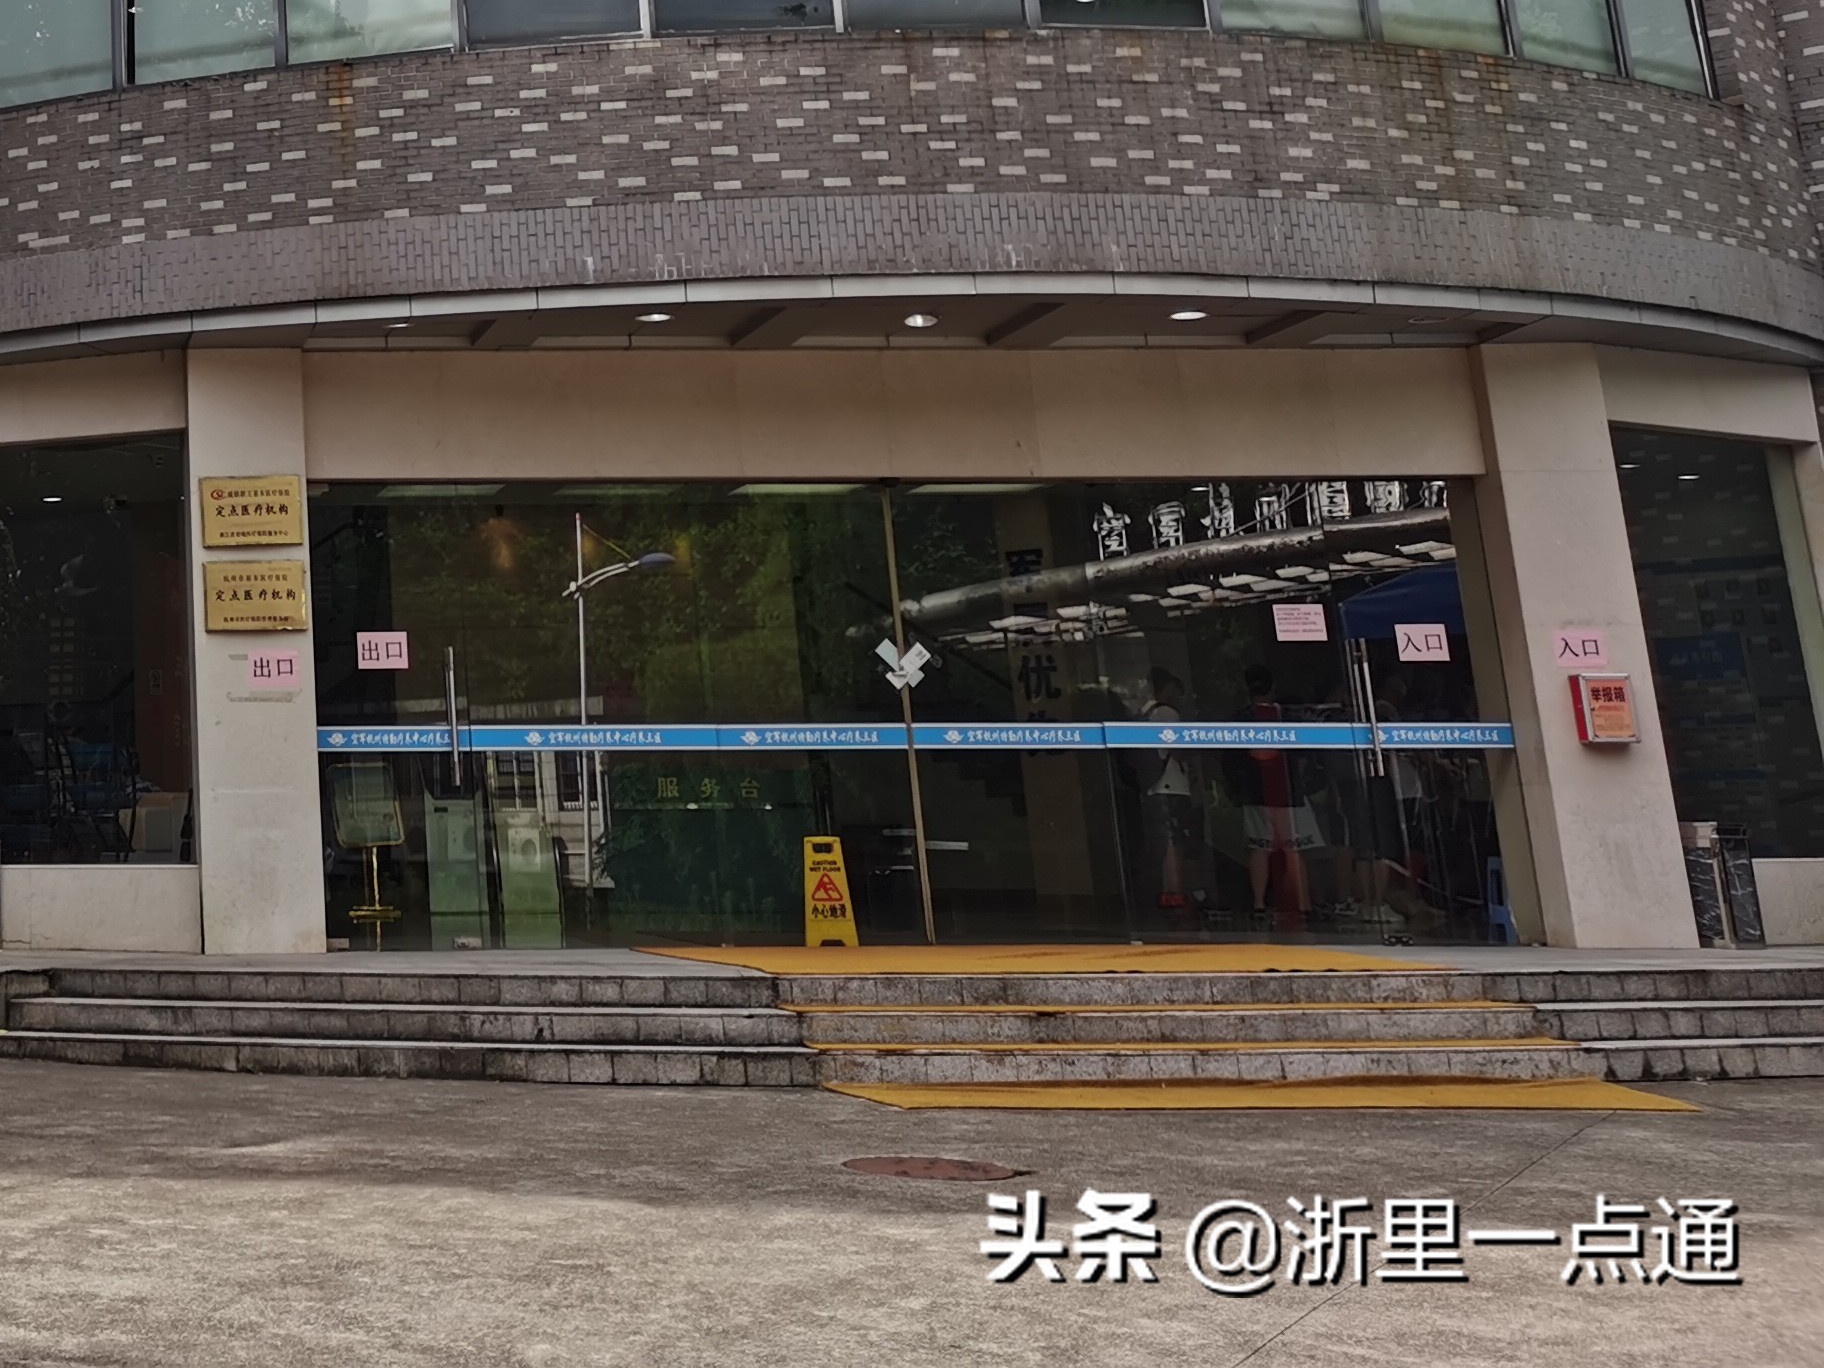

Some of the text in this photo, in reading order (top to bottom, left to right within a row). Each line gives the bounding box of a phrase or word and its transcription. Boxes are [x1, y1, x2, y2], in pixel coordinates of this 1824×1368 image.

[215, 503, 289, 517] 定点医疗机构
[215, 588, 296, 602] 定点医疗机构
[360, 640, 403, 662] 出口
[1400, 632, 1443, 655] 入口
[1559, 637, 1600, 658] 入口
[253, 657, 294, 679] 出口
[1590, 686, 1626, 703] 举报箱
[656, 776, 761, 799] 服务台
[812, 903, 847, 919] 小心地滑
